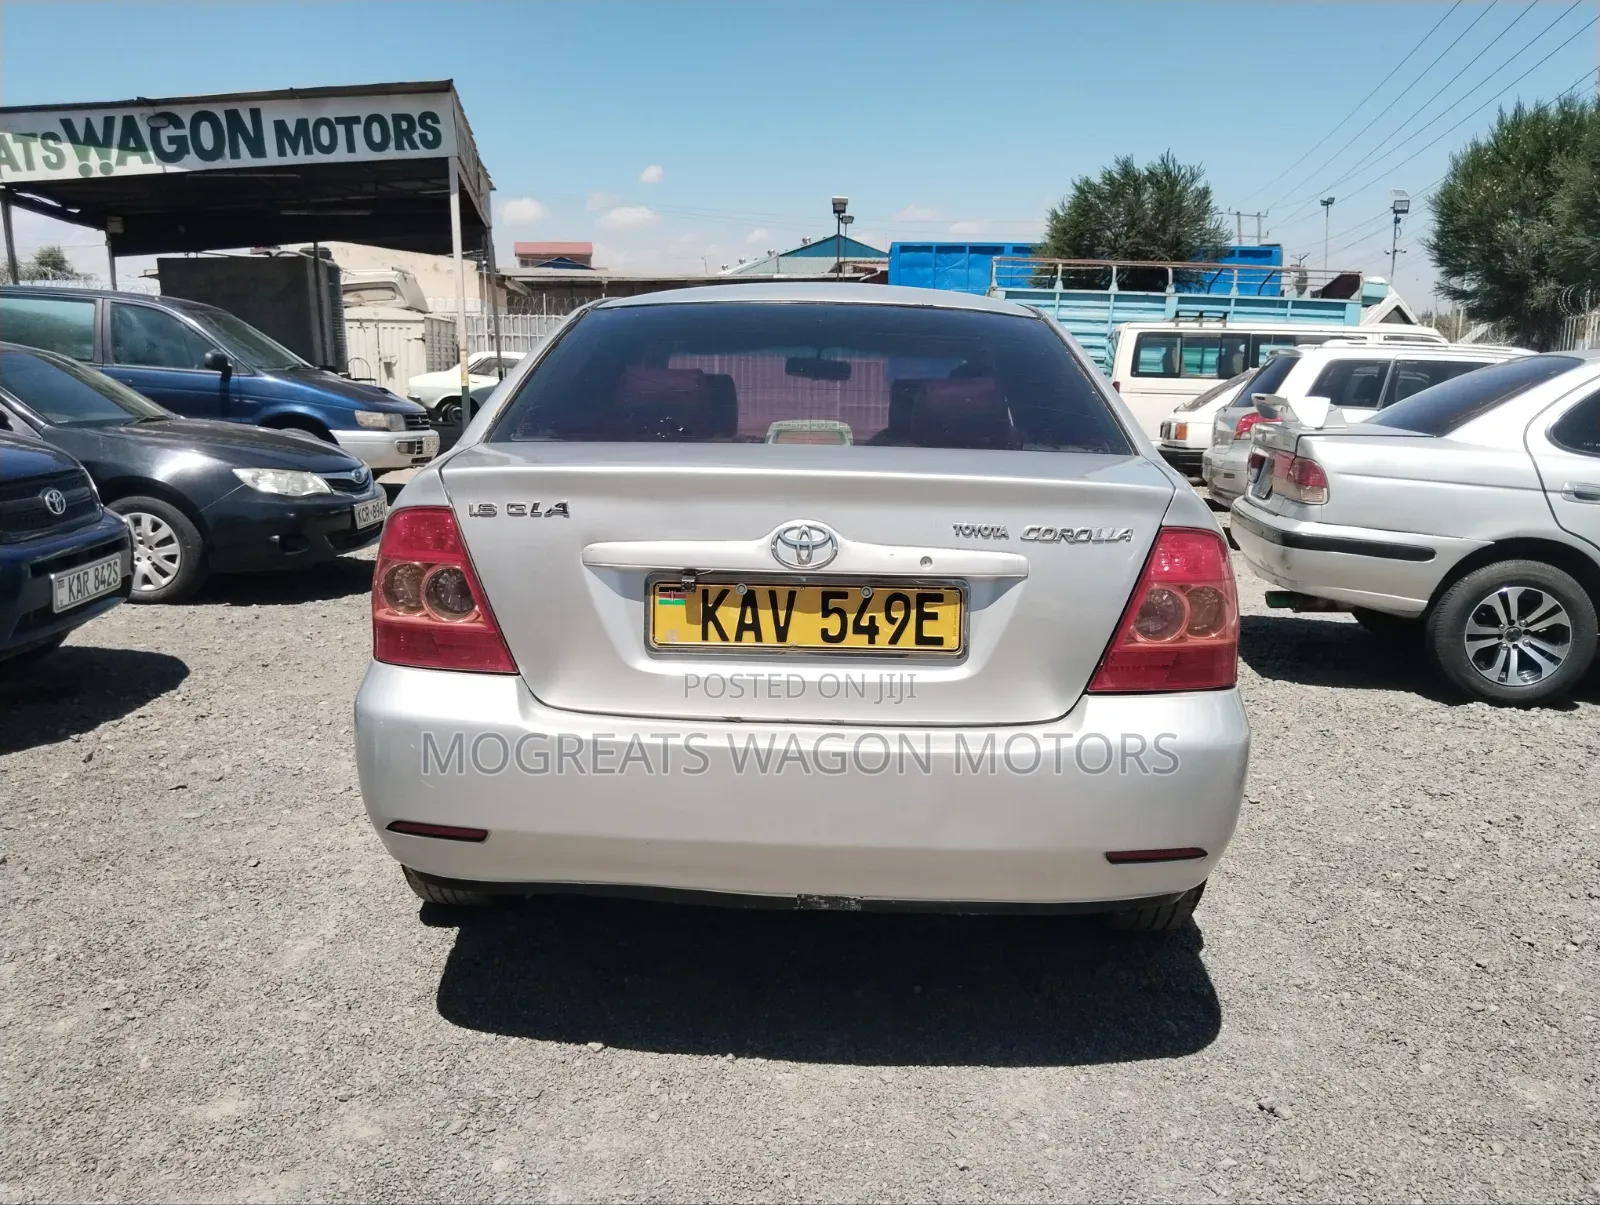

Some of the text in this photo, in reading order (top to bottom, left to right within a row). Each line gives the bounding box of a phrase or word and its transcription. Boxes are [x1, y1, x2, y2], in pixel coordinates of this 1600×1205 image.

[59, 107, 267, 168] WAGON
[273, 111, 442, 157] MOTORS
[952, 522, 1133, 544] TOYOTA COROLLA
[68, 560, 119, 602] KAR 842S
[701, 588, 797, 642] KAV
[820, 590, 945, 646] 549E
